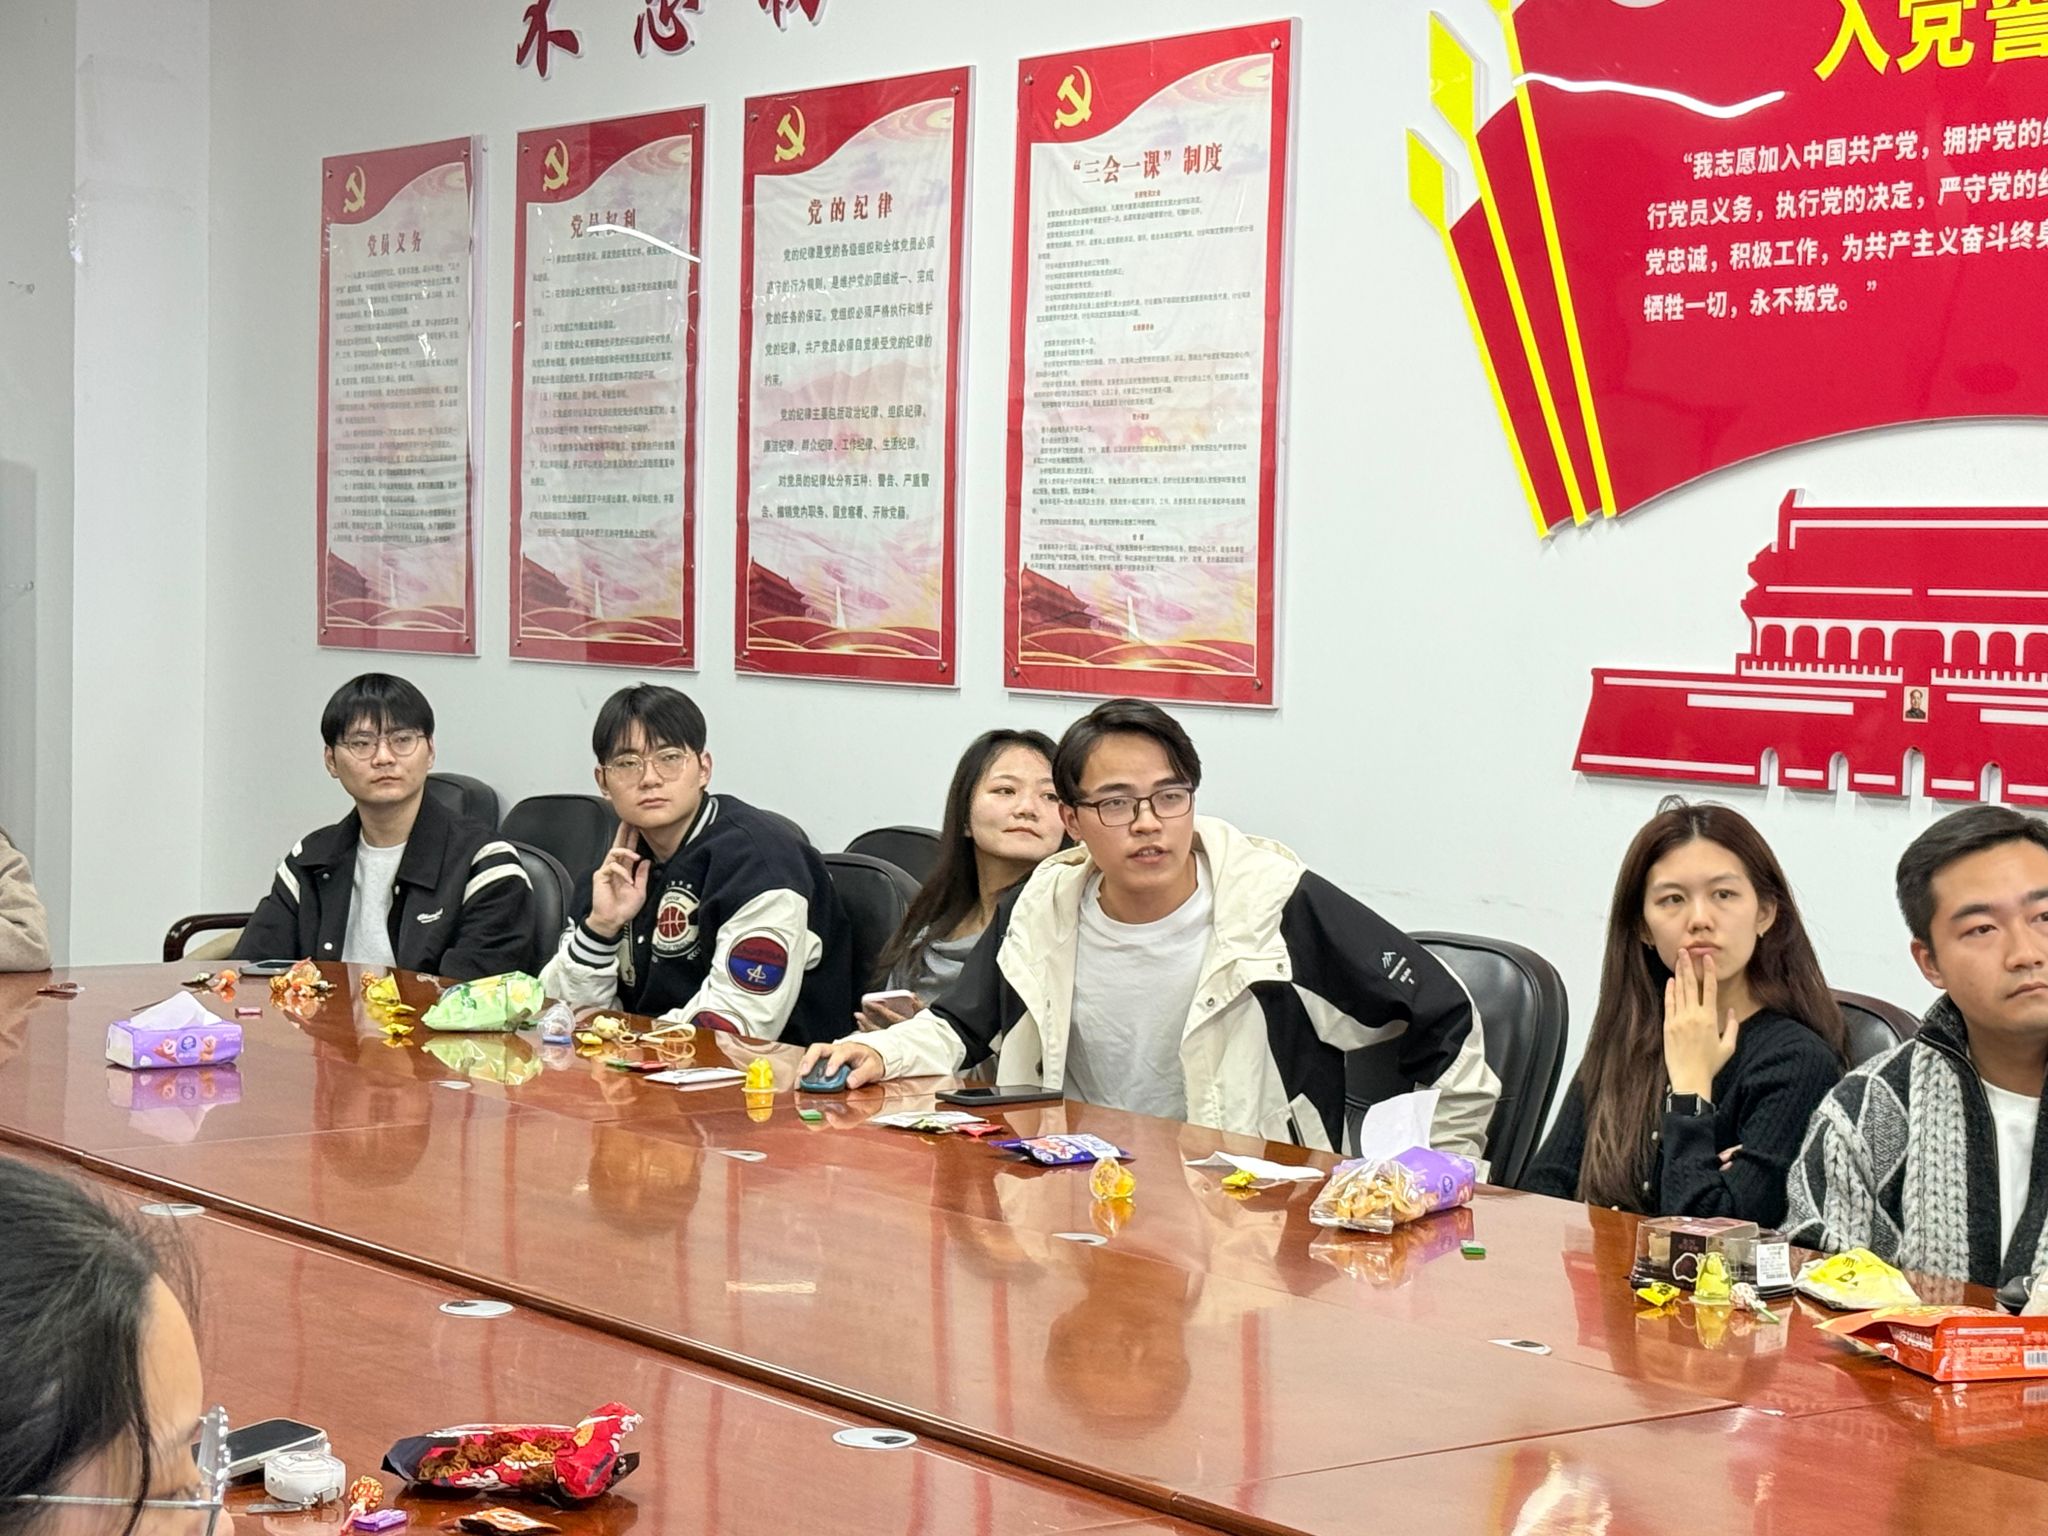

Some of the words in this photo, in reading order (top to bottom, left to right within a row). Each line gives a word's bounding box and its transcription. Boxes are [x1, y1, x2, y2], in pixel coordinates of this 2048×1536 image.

[1073, 142, 1222, 185] “三会一课”制度
[1683, 117, 2048, 181] “我志愿加入中国共产党，拥护党的
[808, 192, 893, 226] 党的纪律
[1643, 280, 1878, 322] 牺牲一切，永不叛党。”
